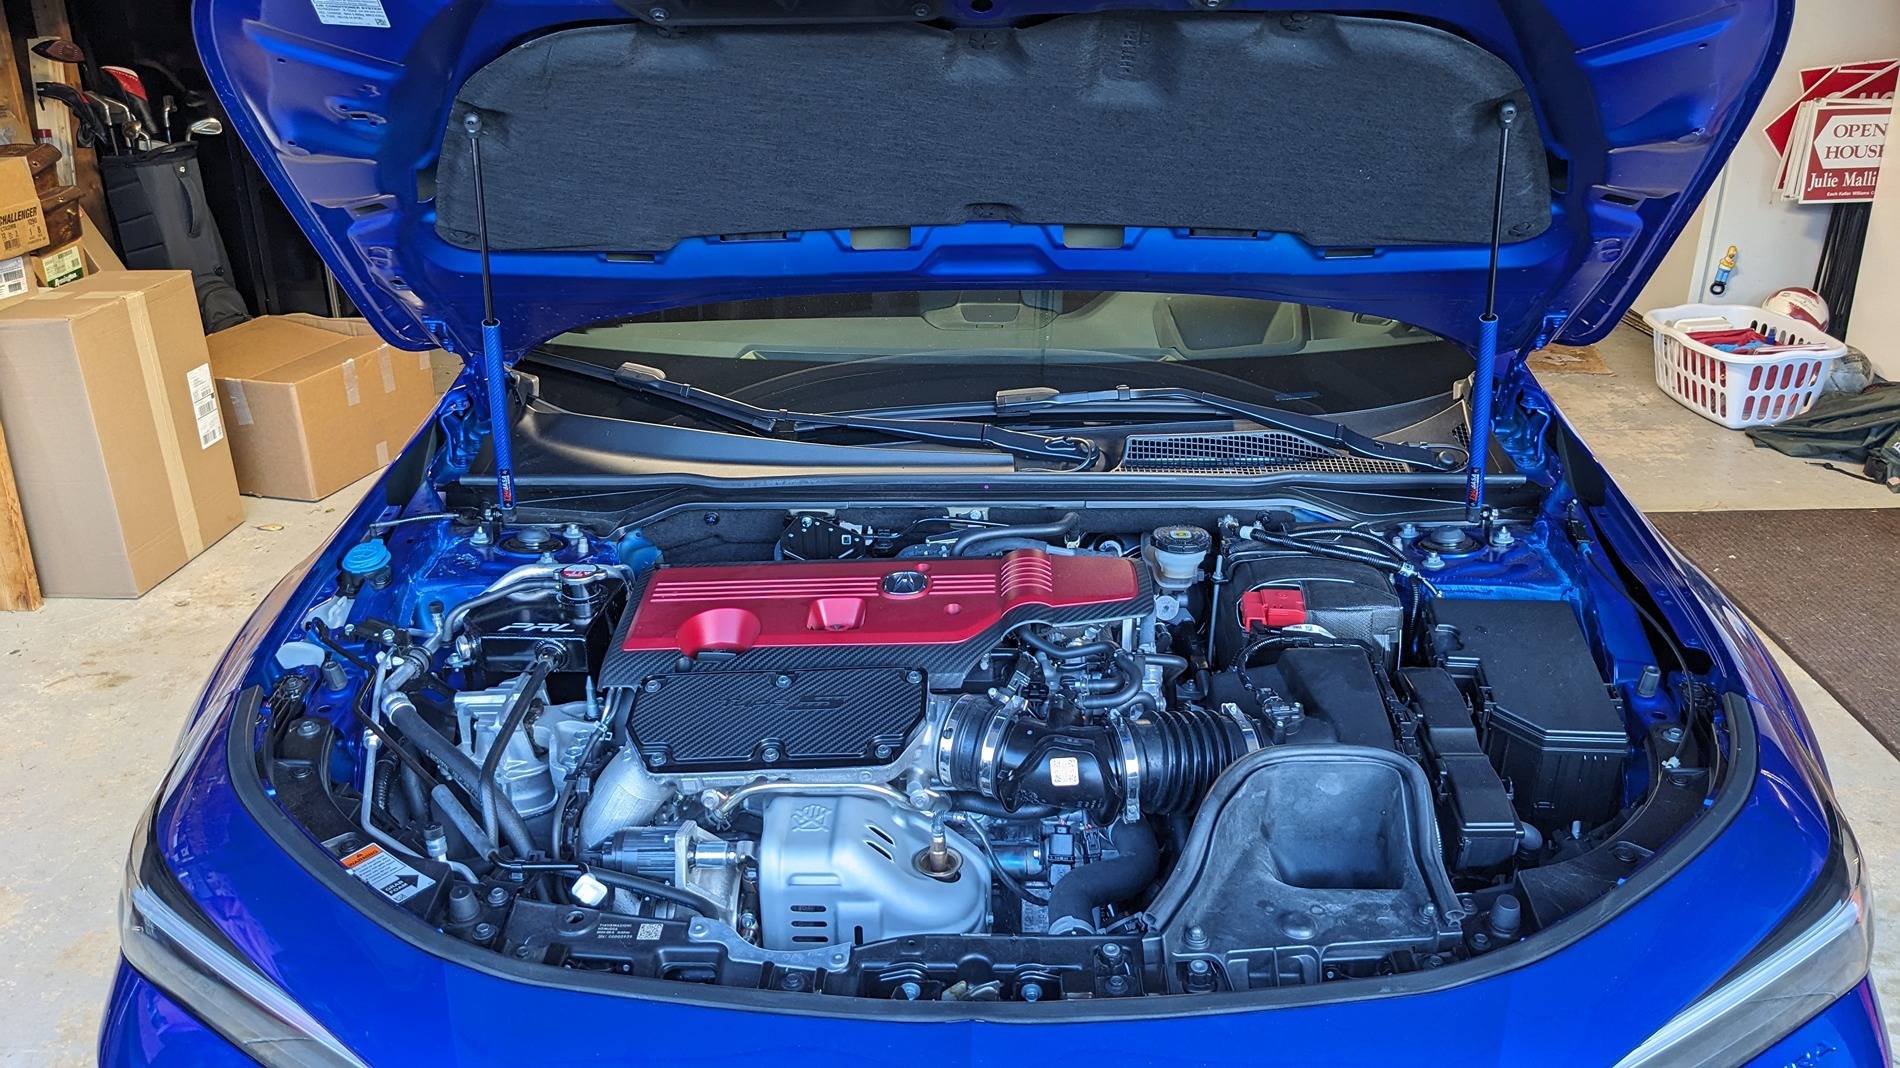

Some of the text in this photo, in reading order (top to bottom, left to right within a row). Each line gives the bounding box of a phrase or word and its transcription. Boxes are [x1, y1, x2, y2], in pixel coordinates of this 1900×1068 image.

[1833, 122, 1888, 138] OPEN
[1808, 172, 1839, 192] Julie
[498, 622, 575, 633] PRL
